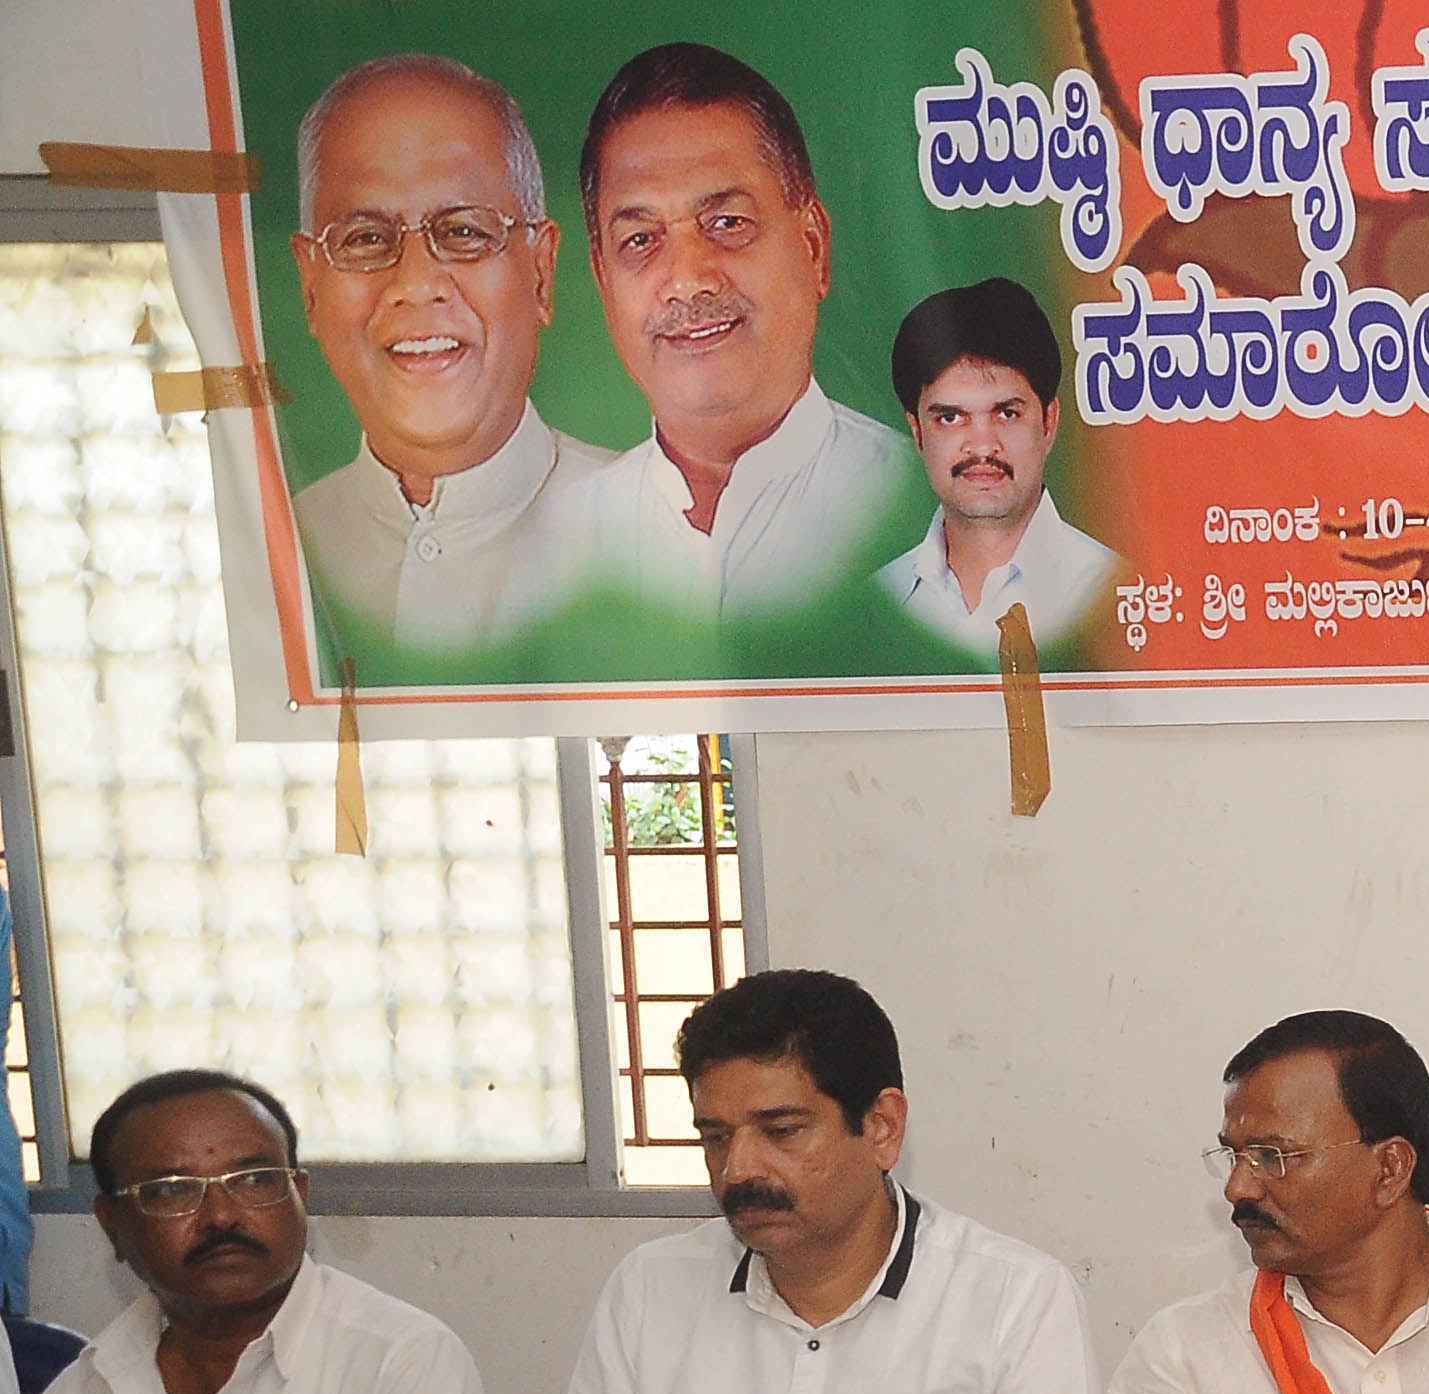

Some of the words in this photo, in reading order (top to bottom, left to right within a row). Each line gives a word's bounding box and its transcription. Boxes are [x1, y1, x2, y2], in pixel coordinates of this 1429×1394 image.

[1149, 40, 1345, 252] ಧಾನ್ಯ
[1204, 496, 1320, 543] ದಿನಾಂಕ
[1201, 574, 1246, 640] ಶ್ರೀ
